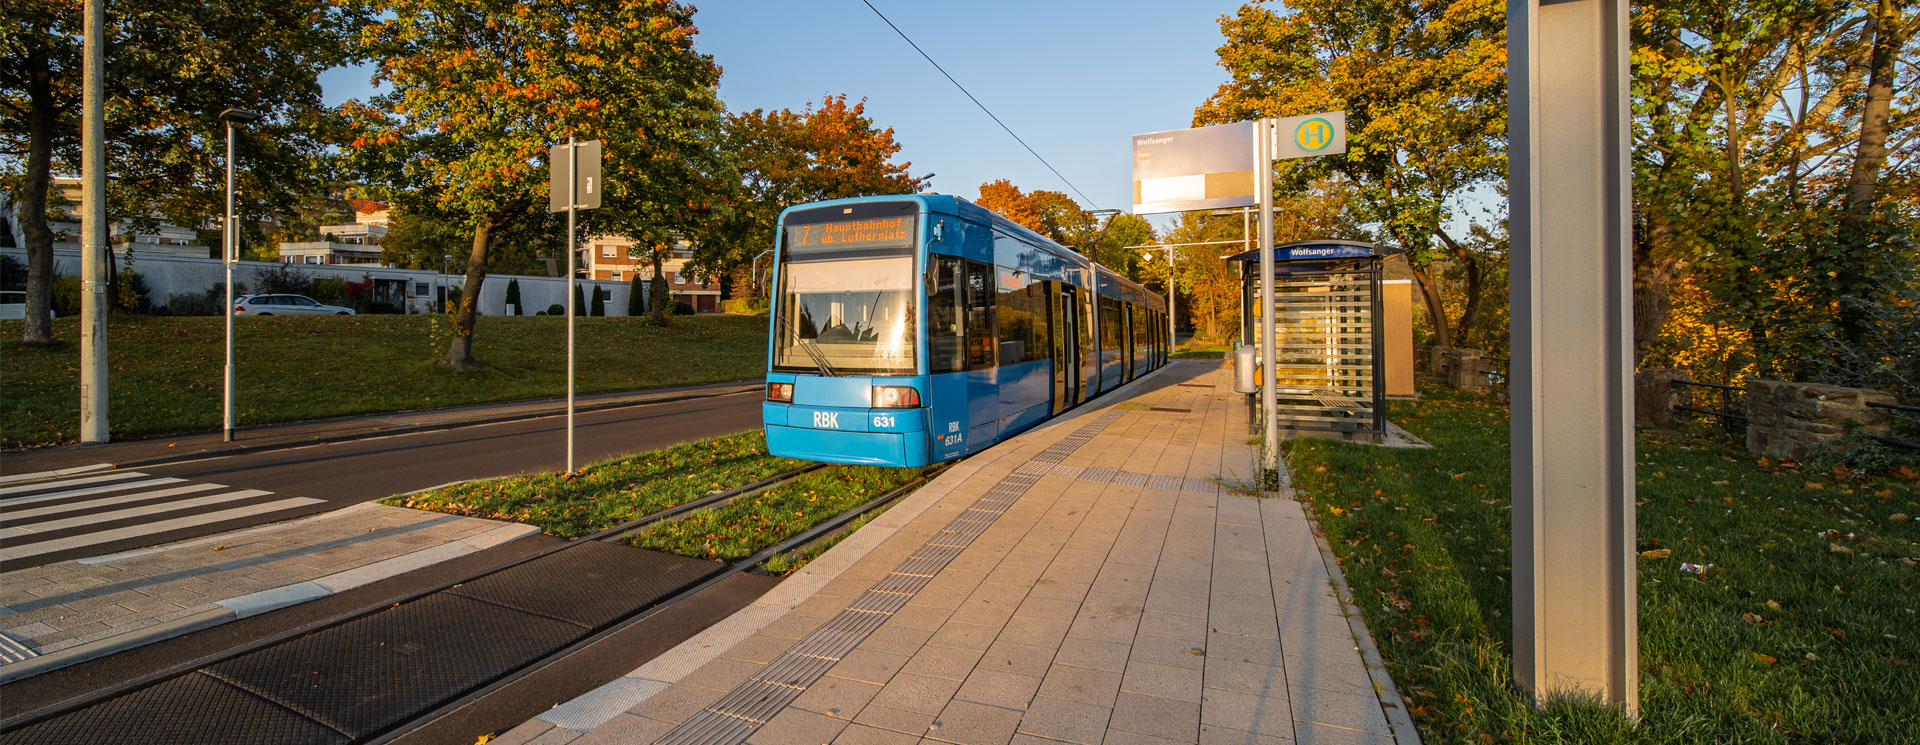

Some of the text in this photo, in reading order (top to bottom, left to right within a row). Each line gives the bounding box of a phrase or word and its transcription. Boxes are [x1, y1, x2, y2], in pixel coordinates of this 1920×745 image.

[1136, 136, 1175, 146] Wolfsanger
[825, 217, 903, 232] Hauptbahnhof
[803, 225, 811, 247] 7
[821, 229, 906, 244] üb. Lutherplatz
[1291, 247, 1335, 257] Wolfsanger
[813, 411, 840, 429] RBK
[873, 416, 895, 428] 631
[948, 421, 960, 433] RBK
[945, 432, 962, 447] 631A
